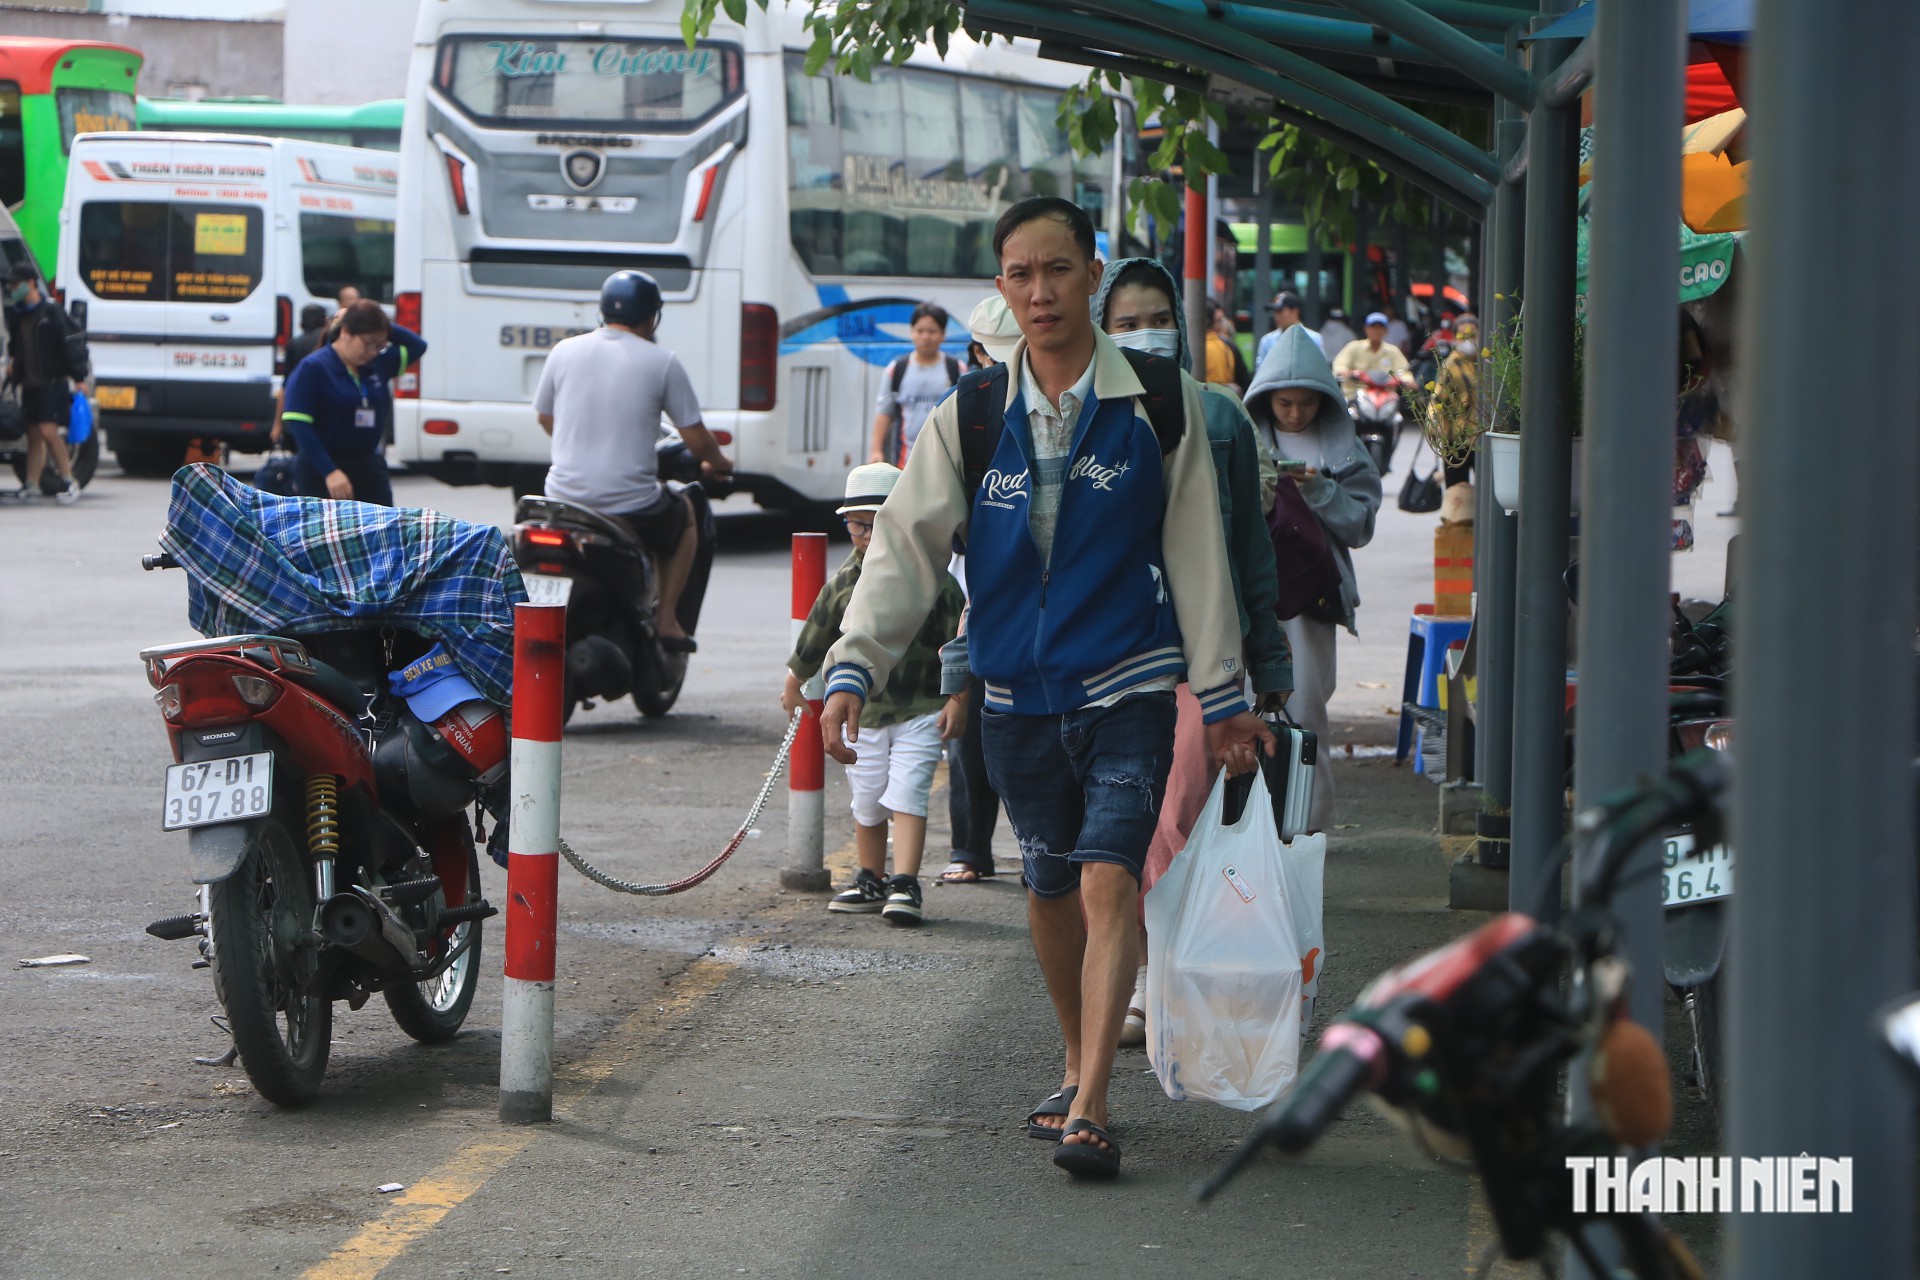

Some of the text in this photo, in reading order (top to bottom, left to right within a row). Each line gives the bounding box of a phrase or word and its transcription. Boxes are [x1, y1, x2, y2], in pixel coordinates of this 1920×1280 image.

[483, 41, 567, 77] Kim
[1680, 259, 1726, 286] CAO
[982, 454, 1120, 500] Red flag
[420, 658, 434, 673] XE
[202, 731, 237, 741] HONDA
[454, 730, 474, 755] QUÂN
[181, 756, 254, 792] 67-D1
[169, 786, 265, 825] 397.88
